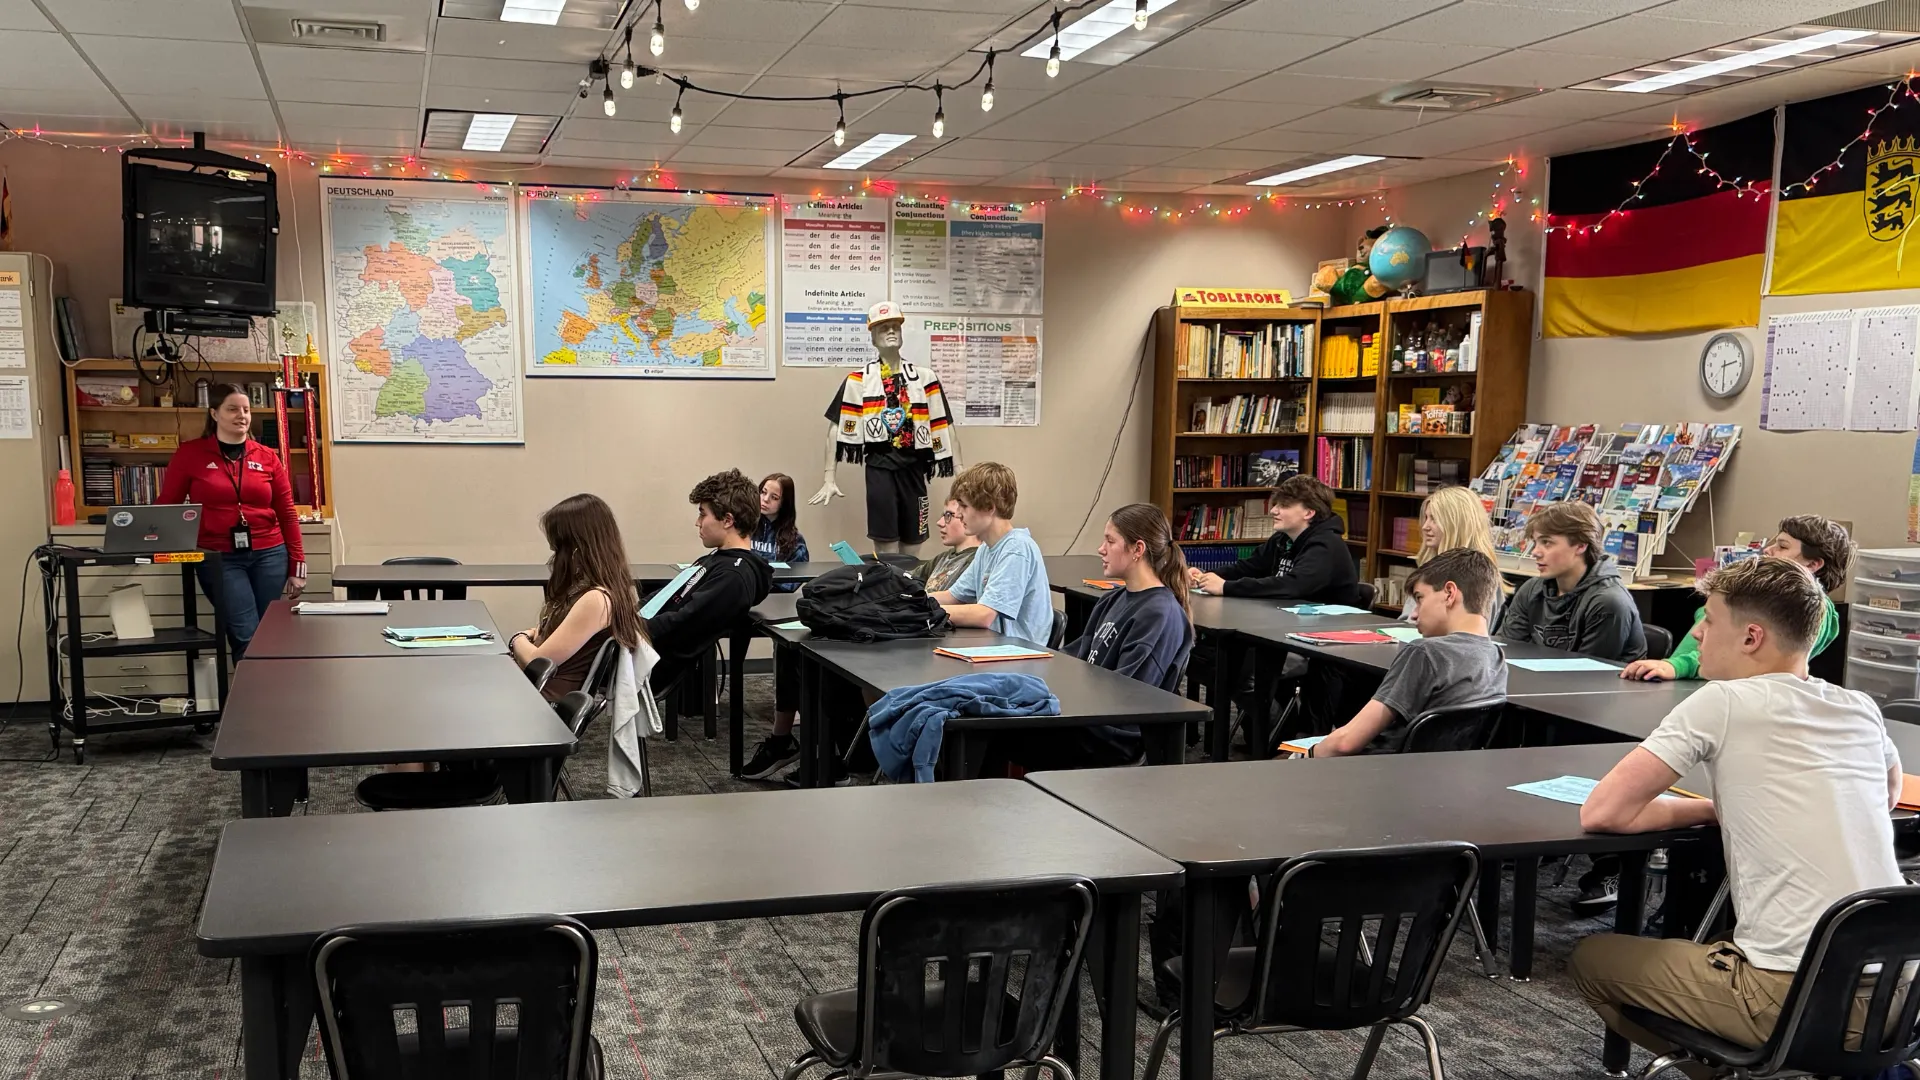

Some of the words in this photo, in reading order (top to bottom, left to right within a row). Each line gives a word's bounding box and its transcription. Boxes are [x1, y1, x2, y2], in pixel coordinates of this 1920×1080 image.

[327, 186, 394, 196] DEUTSCHLAND
[837, 202, 863, 210] Articles
[896, 201, 945, 210] Coordinating
[896, 211, 945, 219] Conjunctions
[970, 213, 1018, 221] Conjunctions
[1196, 290, 1283, 304] TOBLERONE
[924, 320, 1012, 332] PREPOSITIONS
